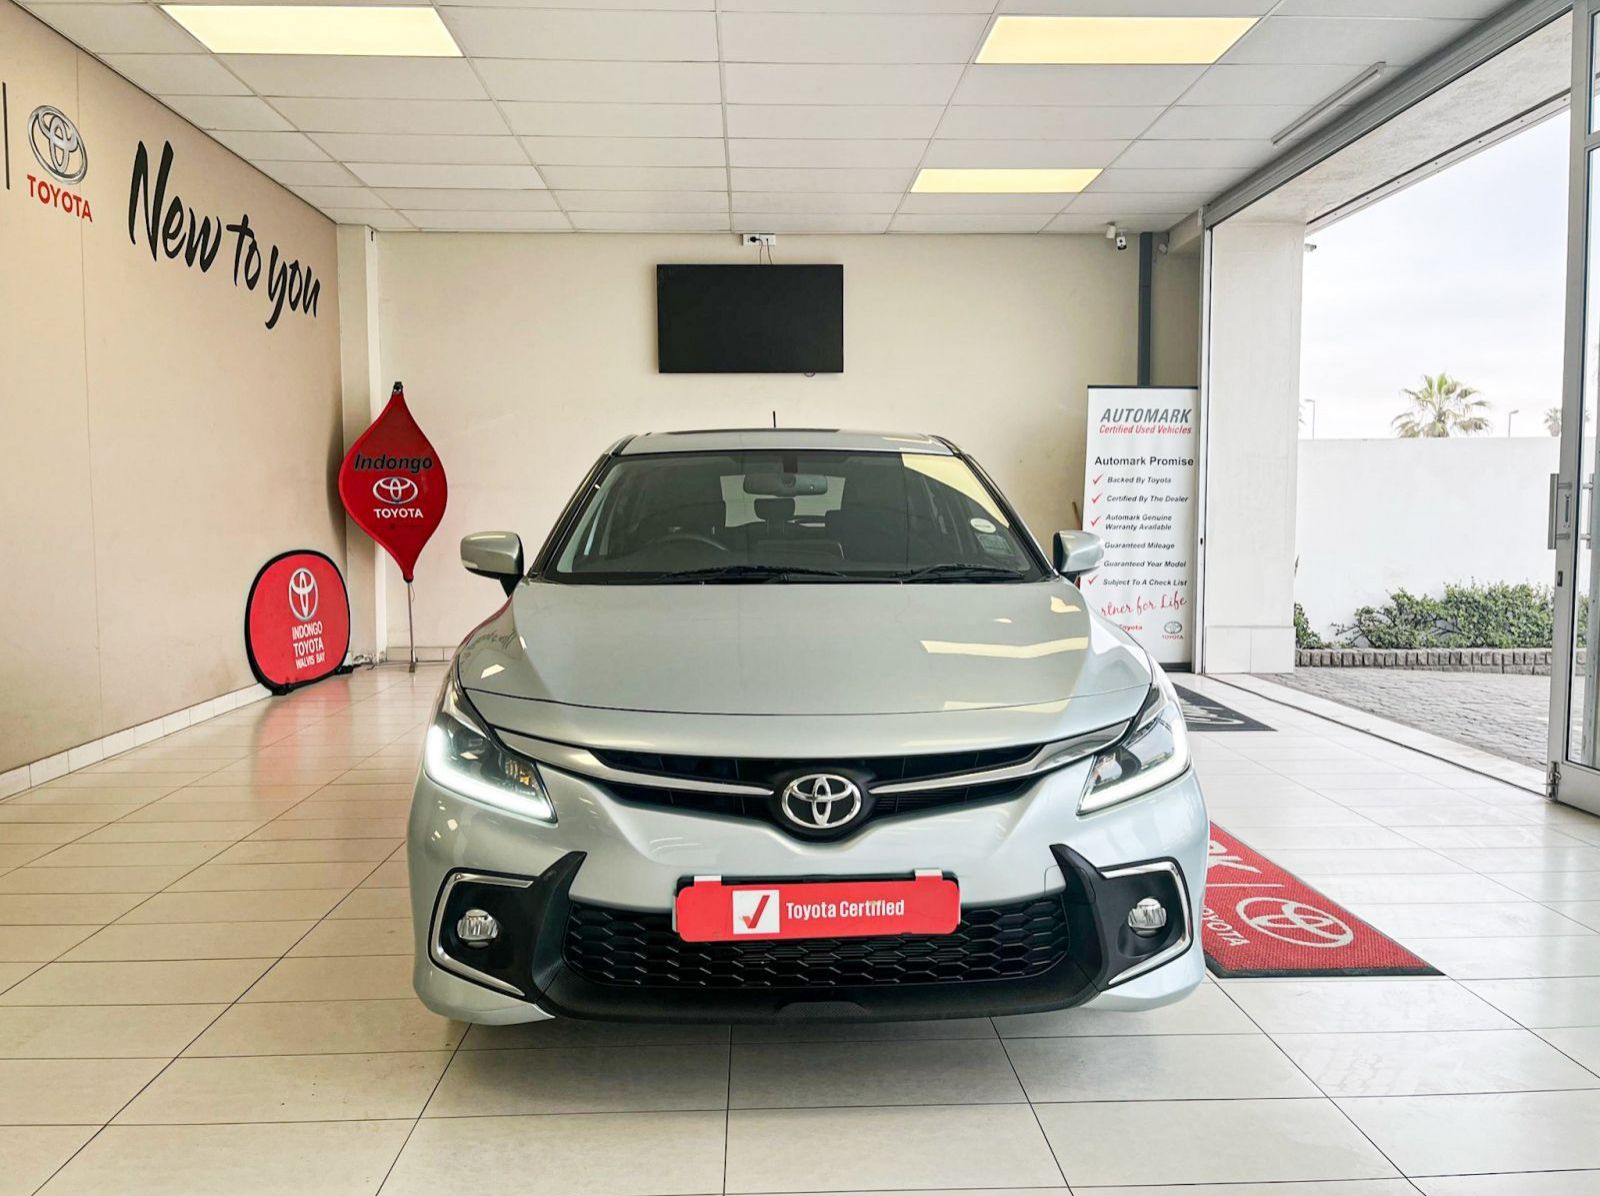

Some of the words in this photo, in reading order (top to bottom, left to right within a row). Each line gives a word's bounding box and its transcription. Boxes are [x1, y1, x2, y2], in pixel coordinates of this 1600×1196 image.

[27, 174, 93, 223] TOYOTA
[128, 140, 222, 273] New
[226, 213, 261, 291] to
[265, 244, 320, 330] you
[1100, 408, 1192, 423] AUTOMARK
[1100, 424, 1134, 434] Certified
[1135, 425, 1155, 434] Used
[1157, 424, 1192, 434] Vehicles
[354, 453, 433, 474] Indongo
[1095, 456, 1146, 466] Automark
[1149, 456, 1194, 466] Promise
[1107, 476, 1134, 484] Backed
[1135, 476, 1145, 485] By
[1147, 476, 1172, 485] Toyota
[1106, 495, 1137, 503] Certified
[1138, 495, 1148, 503] By
[1150, 495, 1164, 503] The
[1165, 495, 1189, 503] Dealer
[373, 508, 424, 519] TOYOTA
[1105, 523, 1137, 531] Warranty
[1139, 523, 1172, 531] Available
[1104, 542, 1146, 550] Guaranteed
[1147, 542, 1175, 550] Mileage
[1147, 560, 1162, 568] Year
[1164, 560, 1187, 568] Model
[1103, 578, 1130, 587] Subject
[1148, 578, 1172, 586] Check
[1101, 601, 1134, 617] rtner
[1136, 595, 1156, 616] for
[1160, 590, 1188, 610] Life
[291, 620, 323, 640] INDONGO
[293, 637, 325, 658] TOYOTA
[295, 654, 315, 670] WALVIS
[315, 651, 326, 664] BAY
[786, 900, 837, 920] Toyota
[839, 899, 905, 917] Certified
